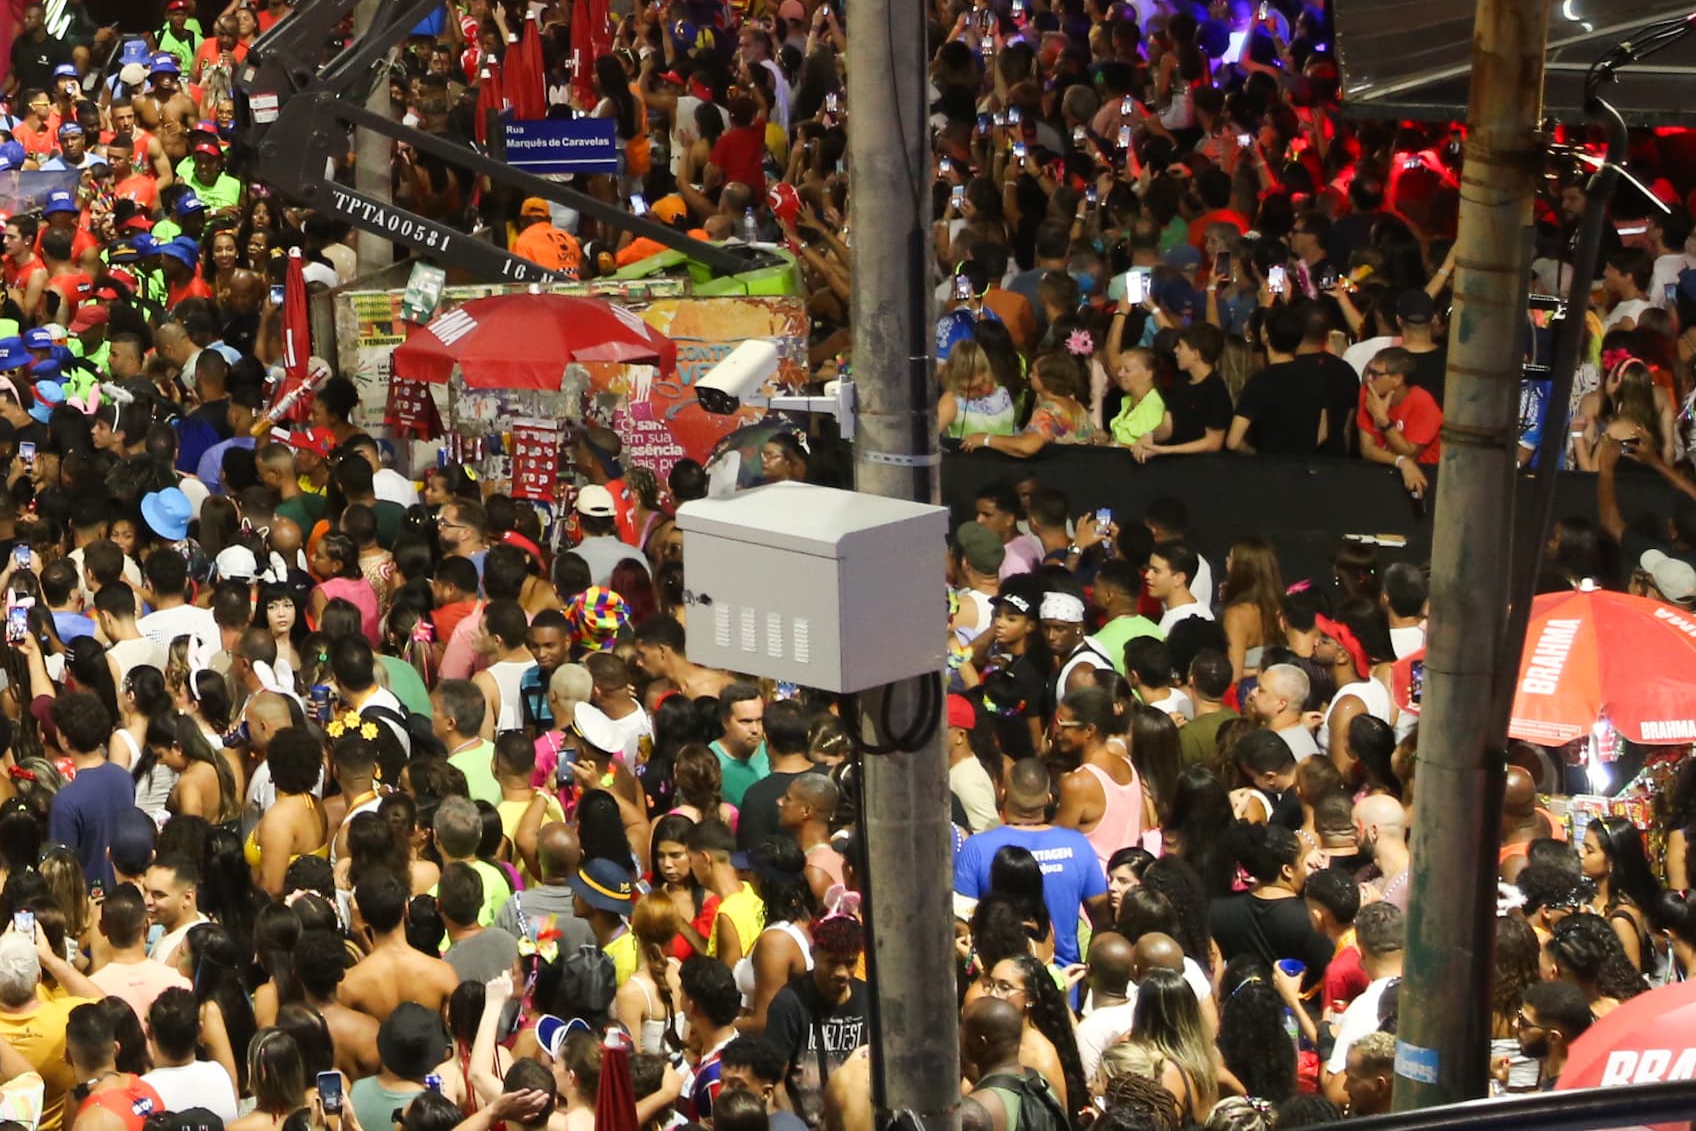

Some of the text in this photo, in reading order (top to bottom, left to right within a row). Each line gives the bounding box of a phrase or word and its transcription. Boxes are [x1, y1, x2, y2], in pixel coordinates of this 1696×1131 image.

[506, 125, 524, 134] Rua
[506, 136, 609, 149] Marquês de Caravelas
[648, 433, 672, 444] sua
[1522, 619, 1582, 695] BRAHMA
[1640, 719, 1696, 740] BRAHMA
